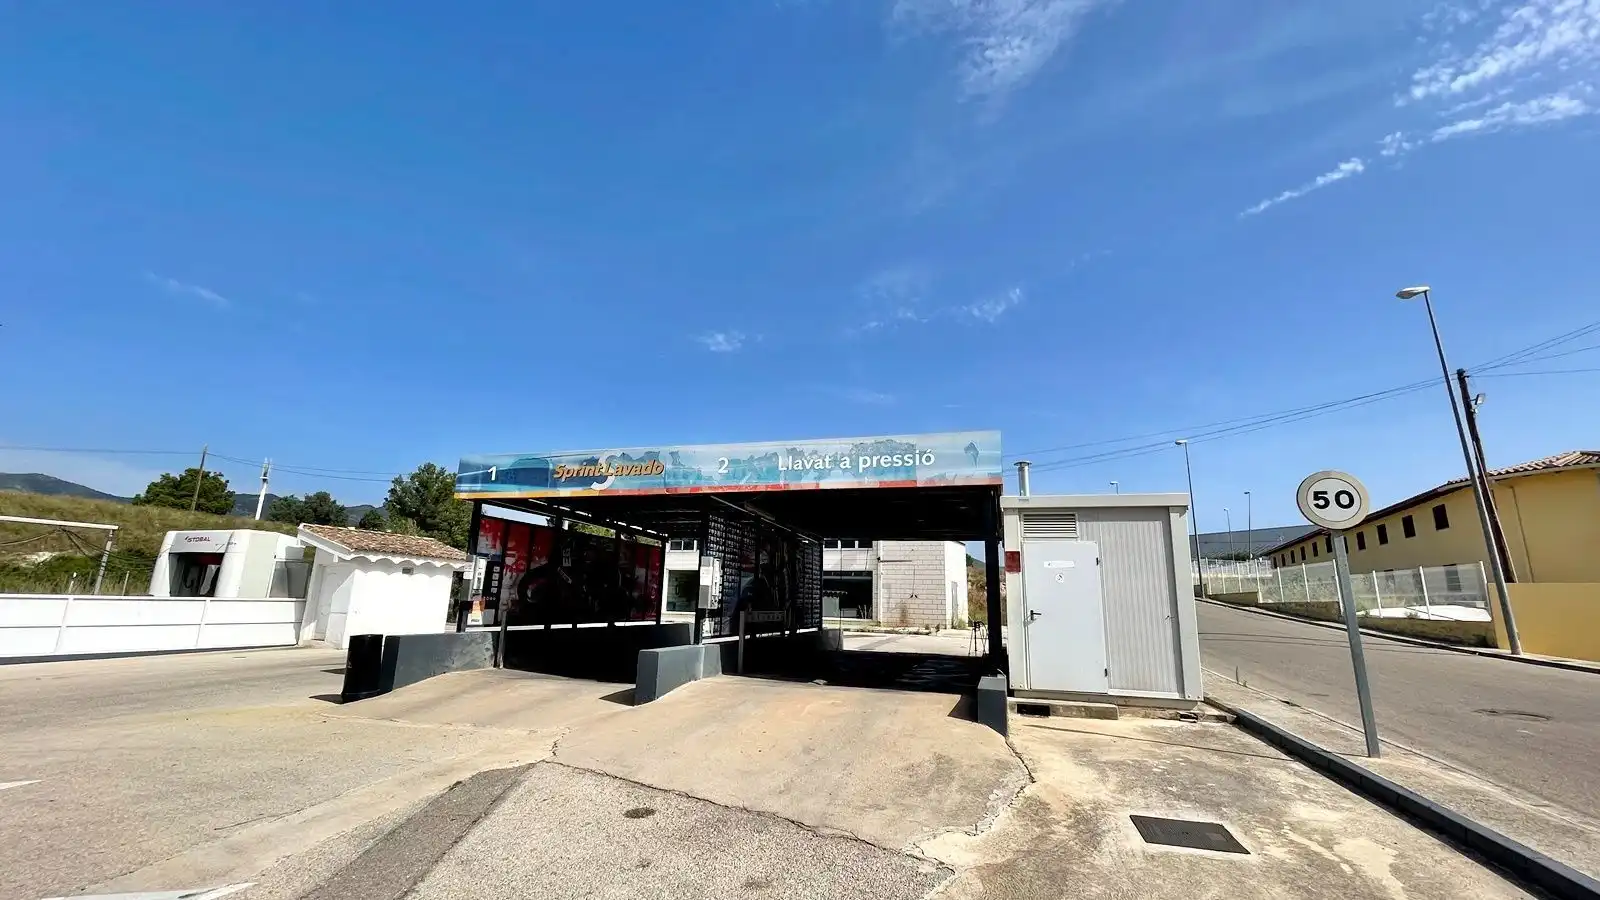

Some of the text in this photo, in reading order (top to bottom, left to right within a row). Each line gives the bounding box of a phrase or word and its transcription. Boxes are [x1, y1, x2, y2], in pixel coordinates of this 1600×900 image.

[717, 457, 729, 474] 2
[778, 448, 936, 473] Llavat a pressió
[487, 465, 498, 481] 1
[1313, 489, 1355, 510] 50
